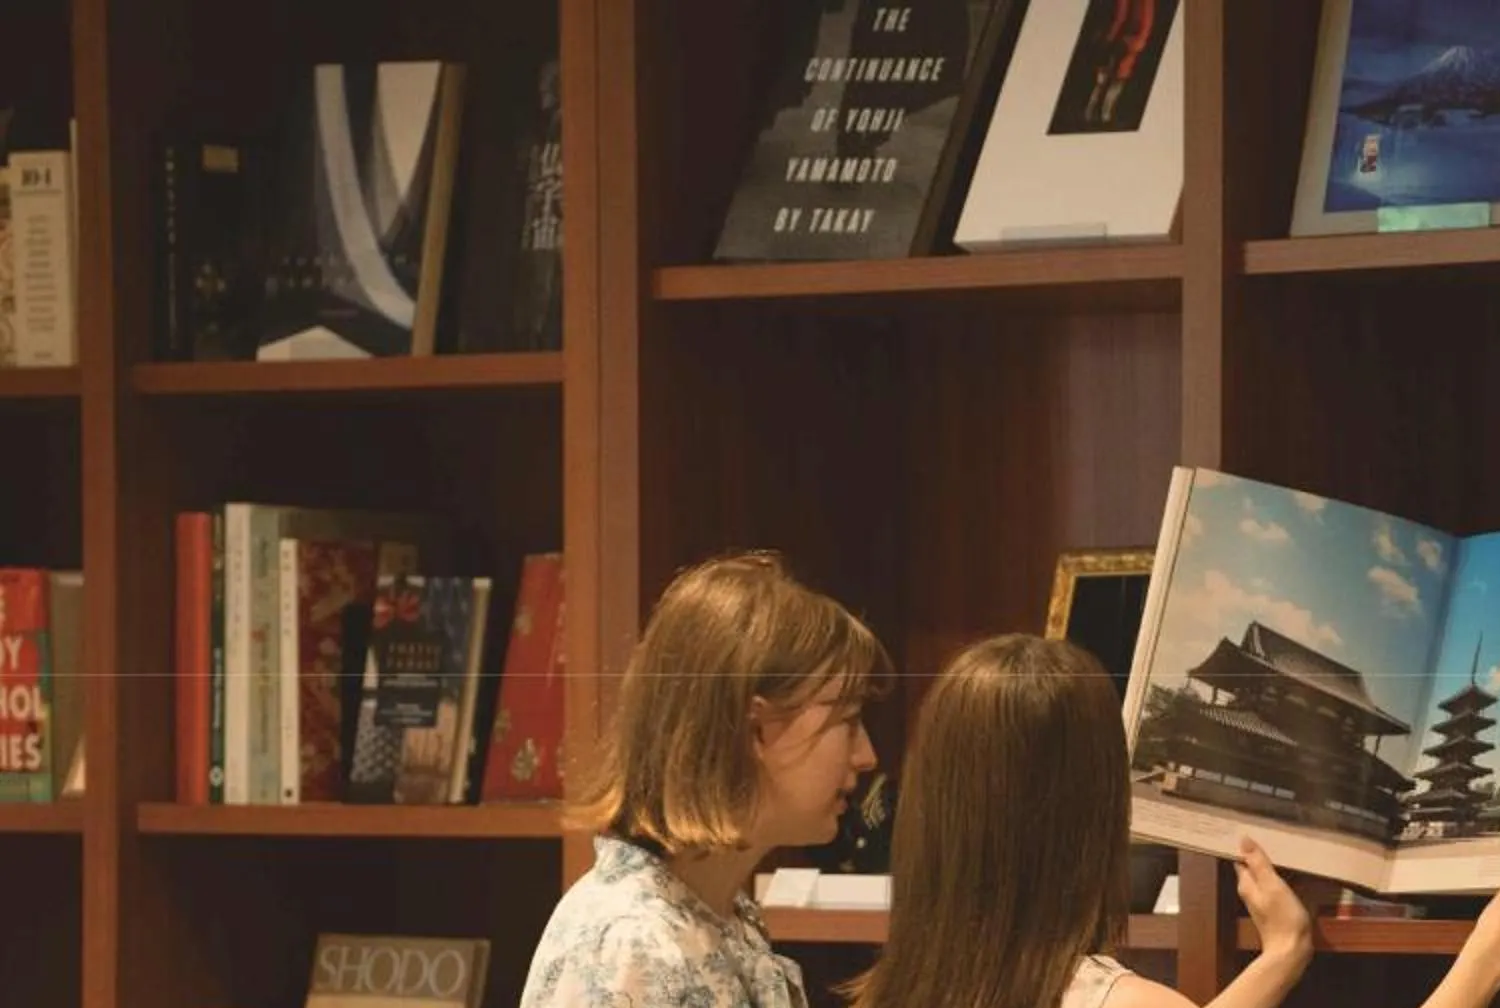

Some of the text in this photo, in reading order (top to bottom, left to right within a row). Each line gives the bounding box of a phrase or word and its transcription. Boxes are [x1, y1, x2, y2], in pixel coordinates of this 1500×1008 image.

[873, 8, 910, 32] THE
[804, 57, 945, 83] CONTINUANCE
[811, 107, 903, 132] OF YOHJI
[786, 158, 897, 183] YAMAMOTO
[774, 209, 875, 234] BY TAKAY
[0, 634, 22, 671] Y
[313, 945, 466, 997] SHODO
